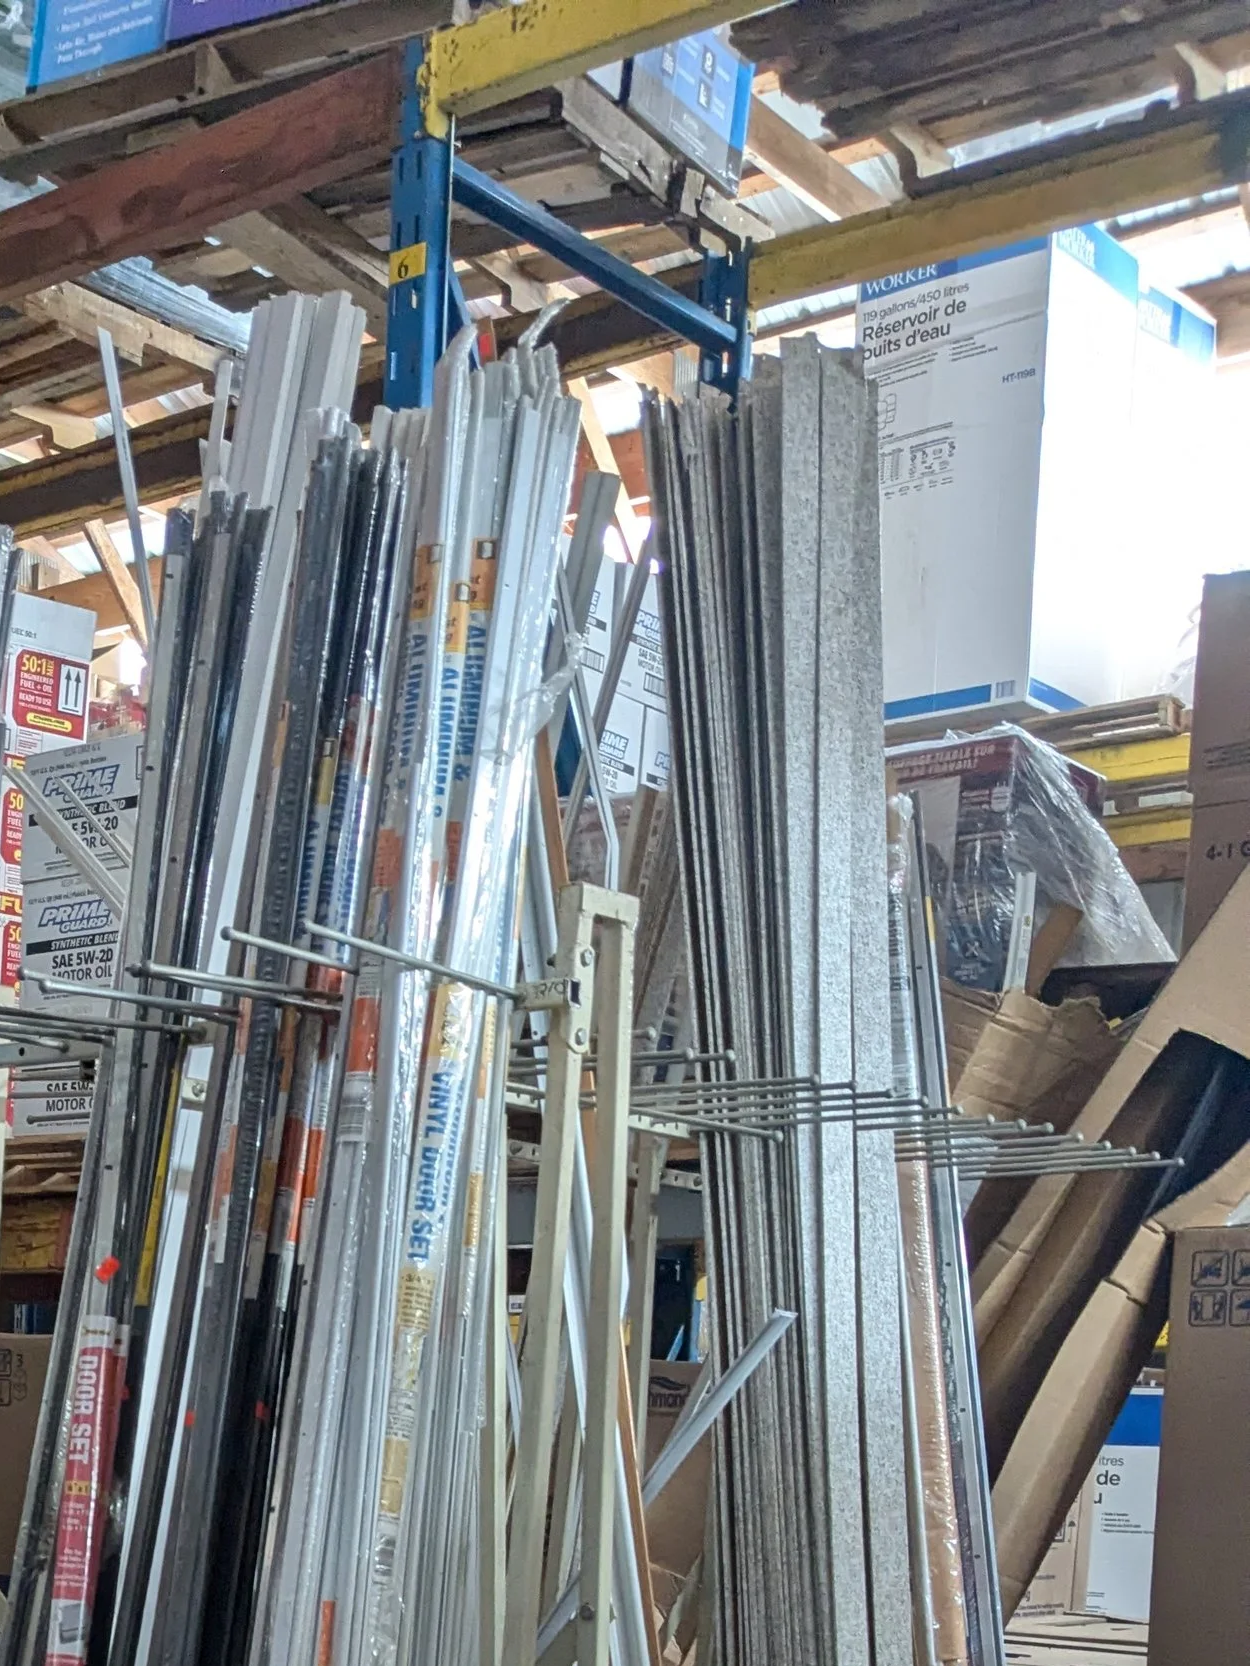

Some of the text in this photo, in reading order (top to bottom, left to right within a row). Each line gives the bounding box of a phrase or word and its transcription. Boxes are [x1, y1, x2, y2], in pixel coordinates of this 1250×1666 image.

[397, 254, 409, 279] 6
[865, 262, 938, 297] WORKER
[862, 281, 971, 323] 119 gallons/450 litres
[862, 299, 968, 342] Réservoir de
[905, 319, 952, 350] d'eau
[1001, 367, 1037, 385] HT-119B
[21, 654, 48, 675] 50:1
[38, 898, 111, 929] PRIME
[59, 914, 111, 934] GUARD
[50, 930, 120, 951] SYNTHETIC BLEND
[52, 948, 114, 970] SAE 5W-20
[95, 963, 113, 979] OIL
[45, 1097, 87, 1113] MOTOR
[422, 1069, 452, 1143] VINYL
[406, 1218, 436, 1263] SET
[69, 1353, 100, 1466] DOOR SET
[1098, 1455, 1125, 1467] itres
[1096, 1470, 1121, 1486] de
